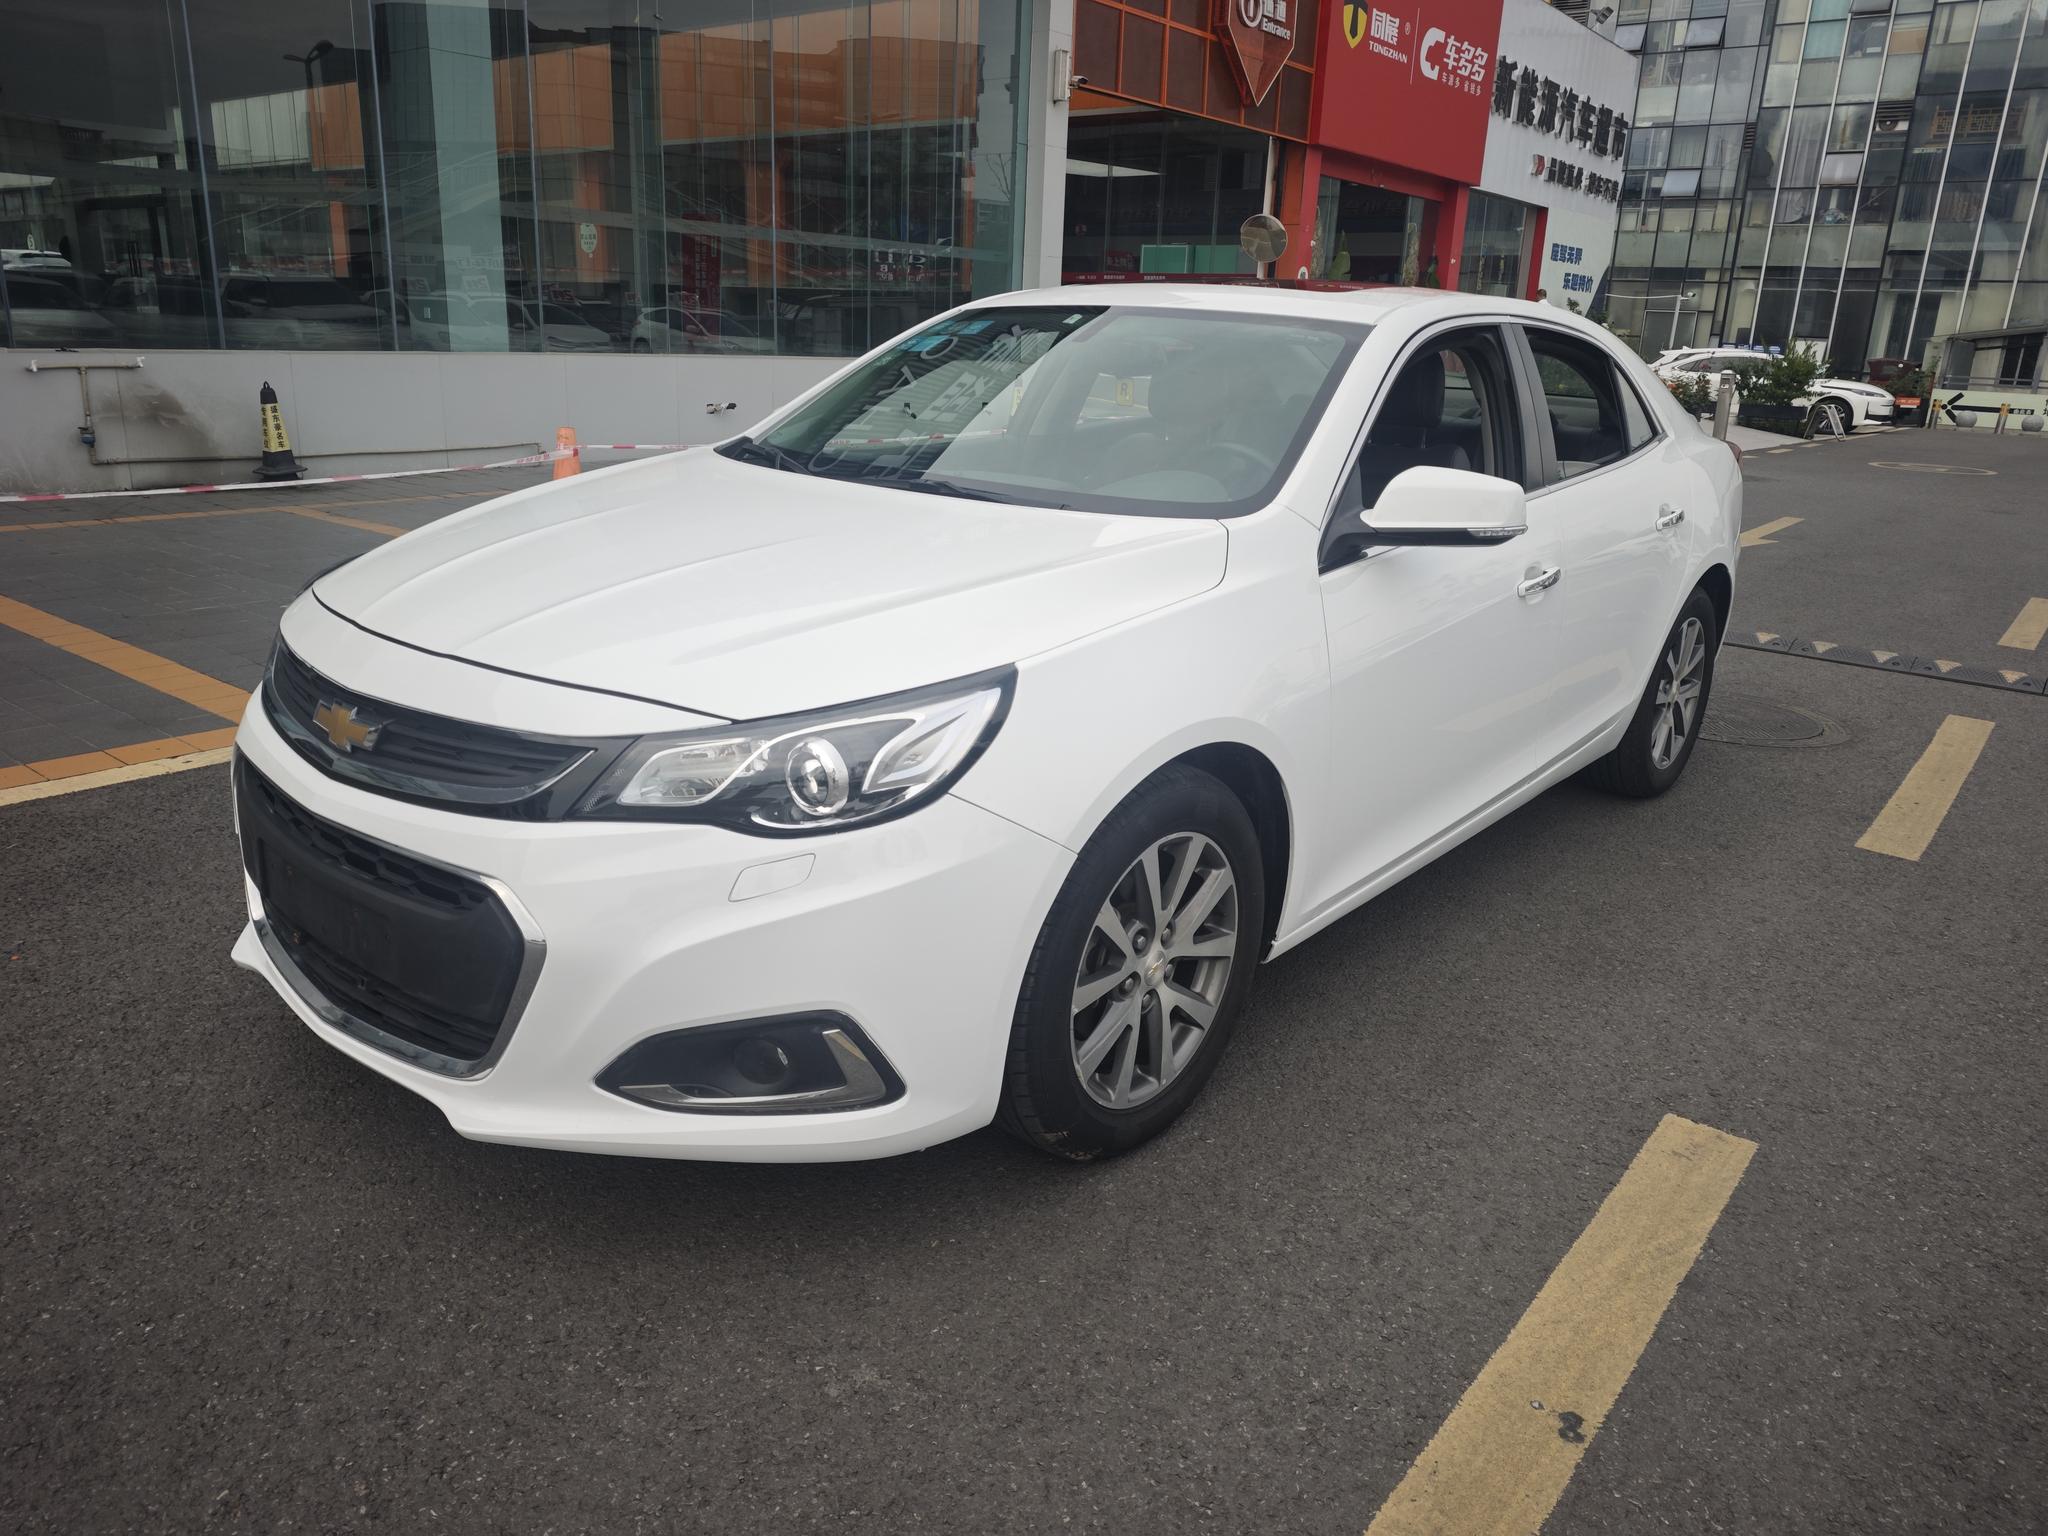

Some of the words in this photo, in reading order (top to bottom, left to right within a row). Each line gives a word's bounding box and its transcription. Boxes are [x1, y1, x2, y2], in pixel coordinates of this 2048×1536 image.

[1262, 17, 1291, 40] Entrance
[1368, 40, 1408, 64] TONGZHAN
[1443, 35, 1489, 82] 车多多
[1493, 55, 1629, 162] 新能源汽车超市
